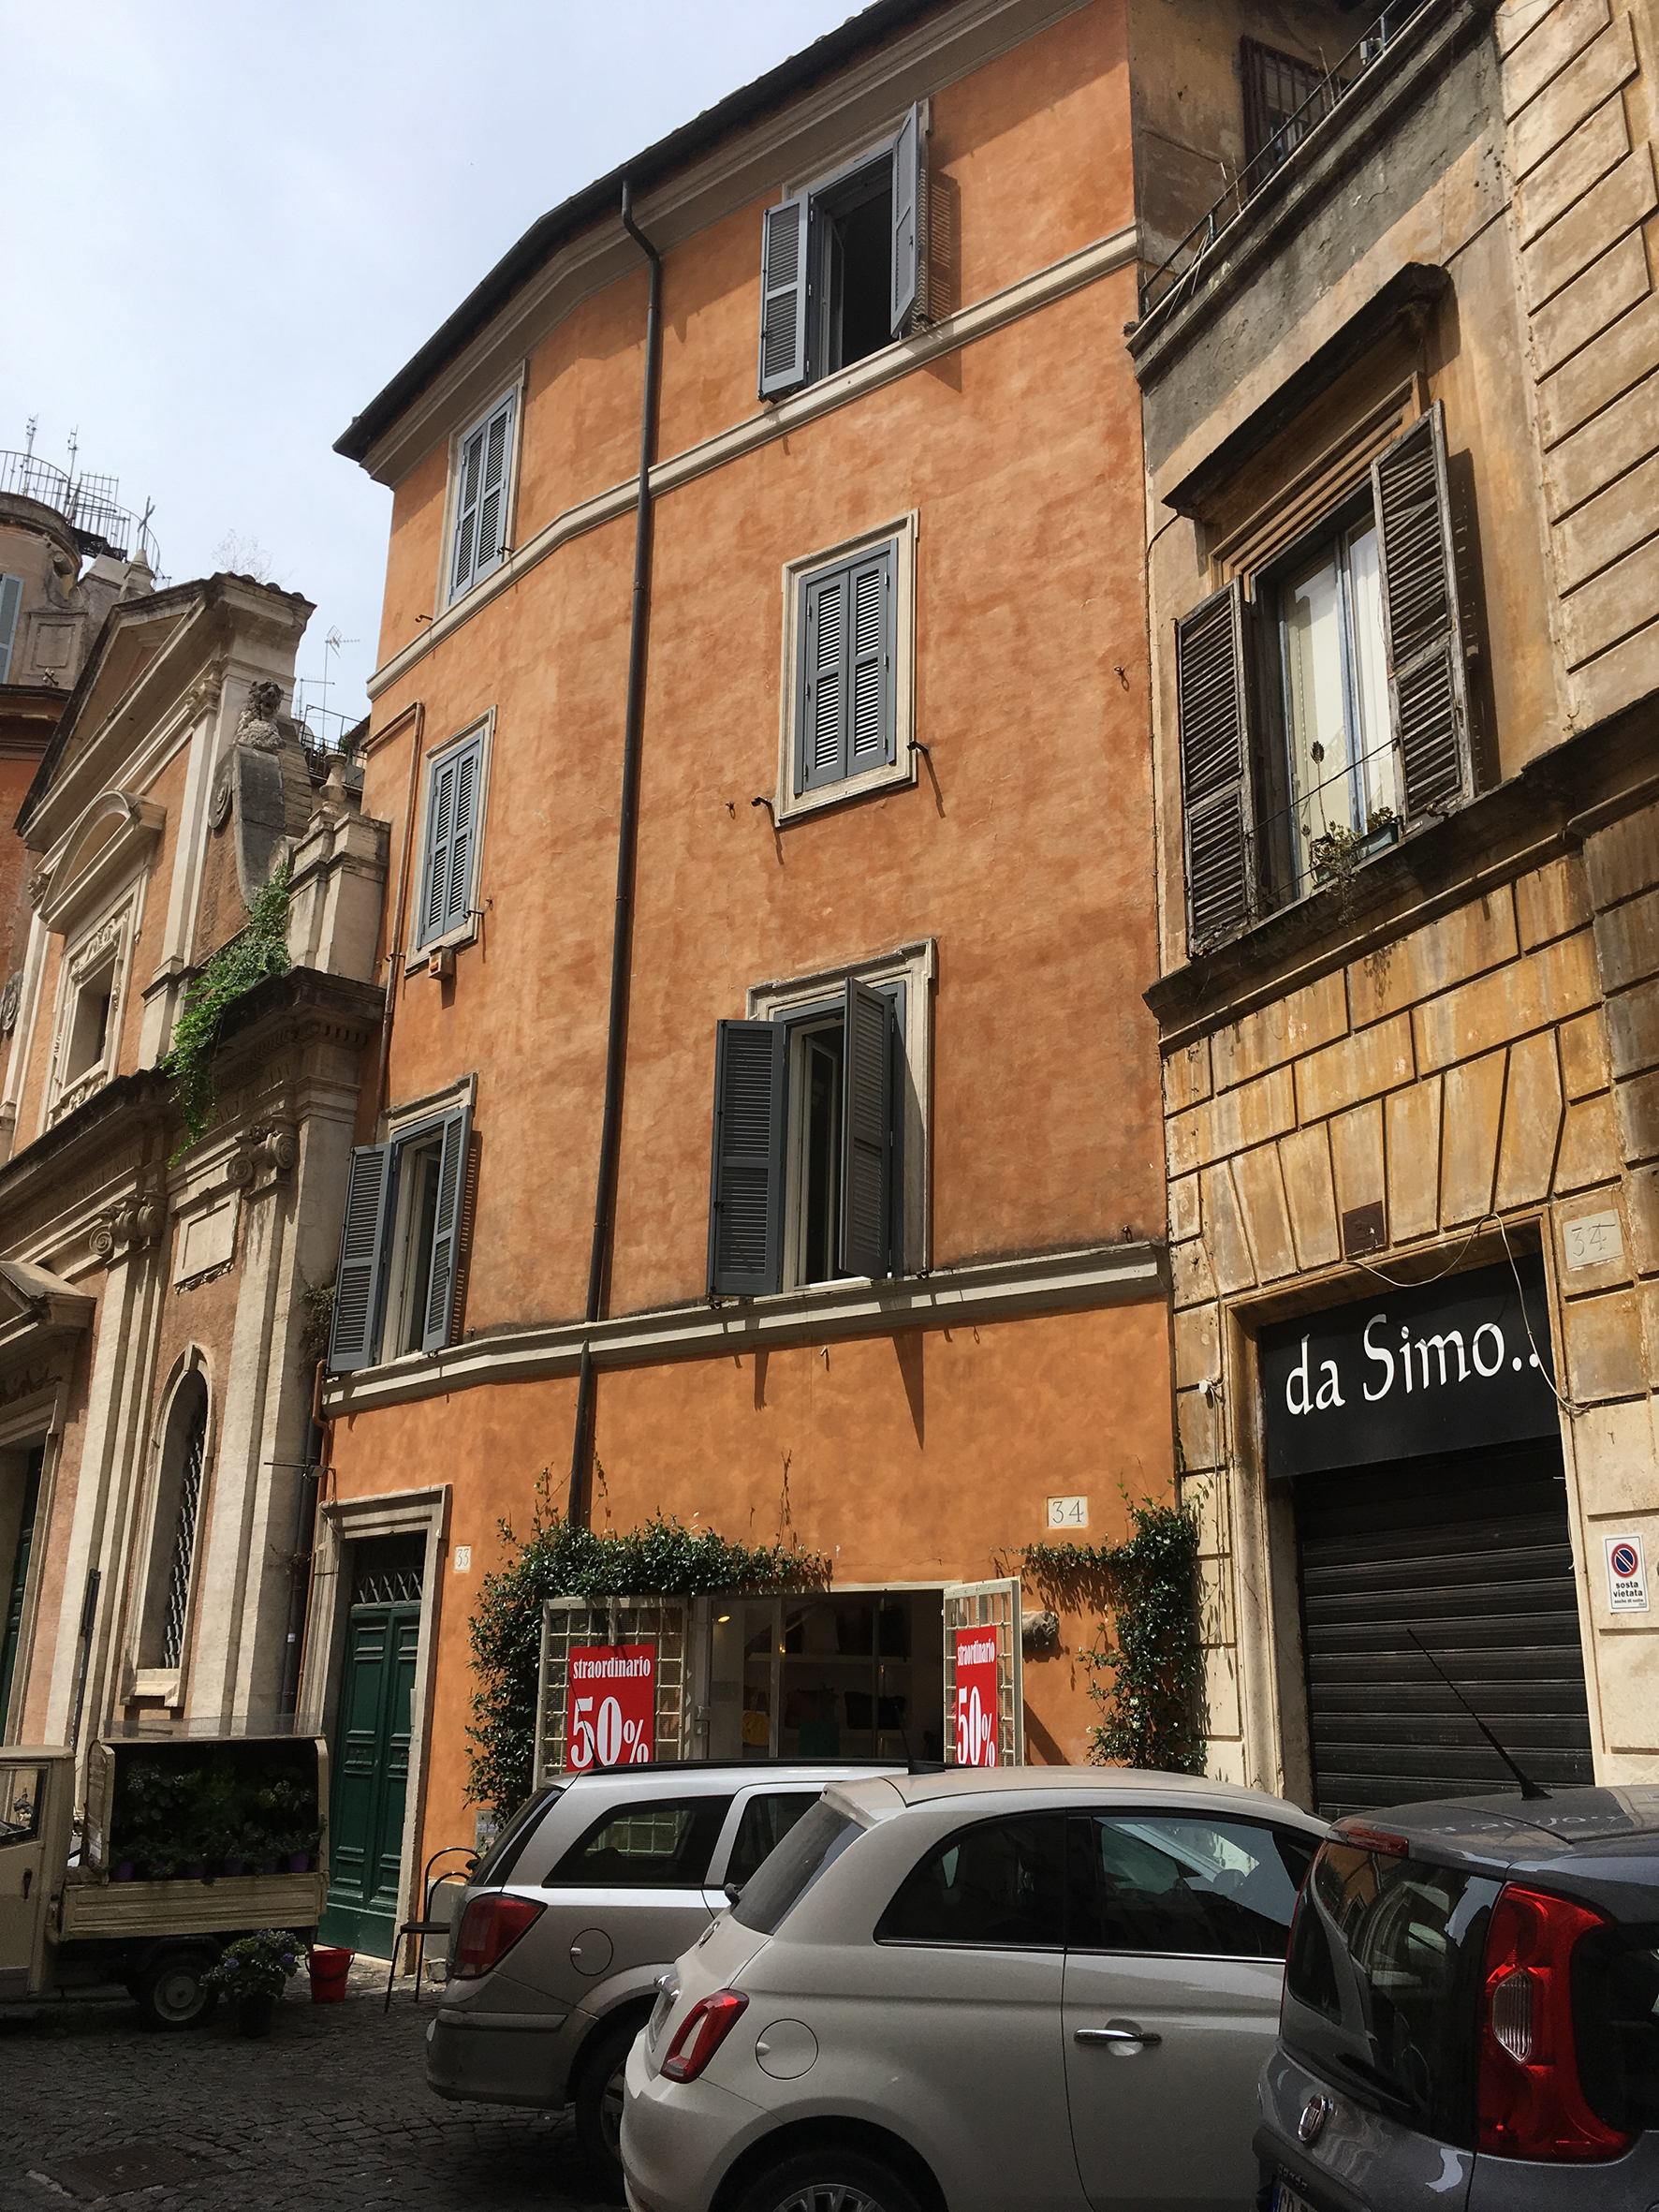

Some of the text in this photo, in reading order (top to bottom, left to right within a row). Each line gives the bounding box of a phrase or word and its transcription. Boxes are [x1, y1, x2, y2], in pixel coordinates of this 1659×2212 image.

[1285, 1334, 1346, 1415] da
[1051, 1499, 1085, 1524] 34
[456, 1548, 469, 1568] 33
[1613, 1588, 1643, 1598] vietata
[1615, 1581, 1638, 1589] sosta
[957, 1638, 995, 1667] straordinario
[573, 1655, 652, 1679] straordinario
[570, 1696, 650, 1768] 50%
[957, 1686, 996, 1768] 50%
